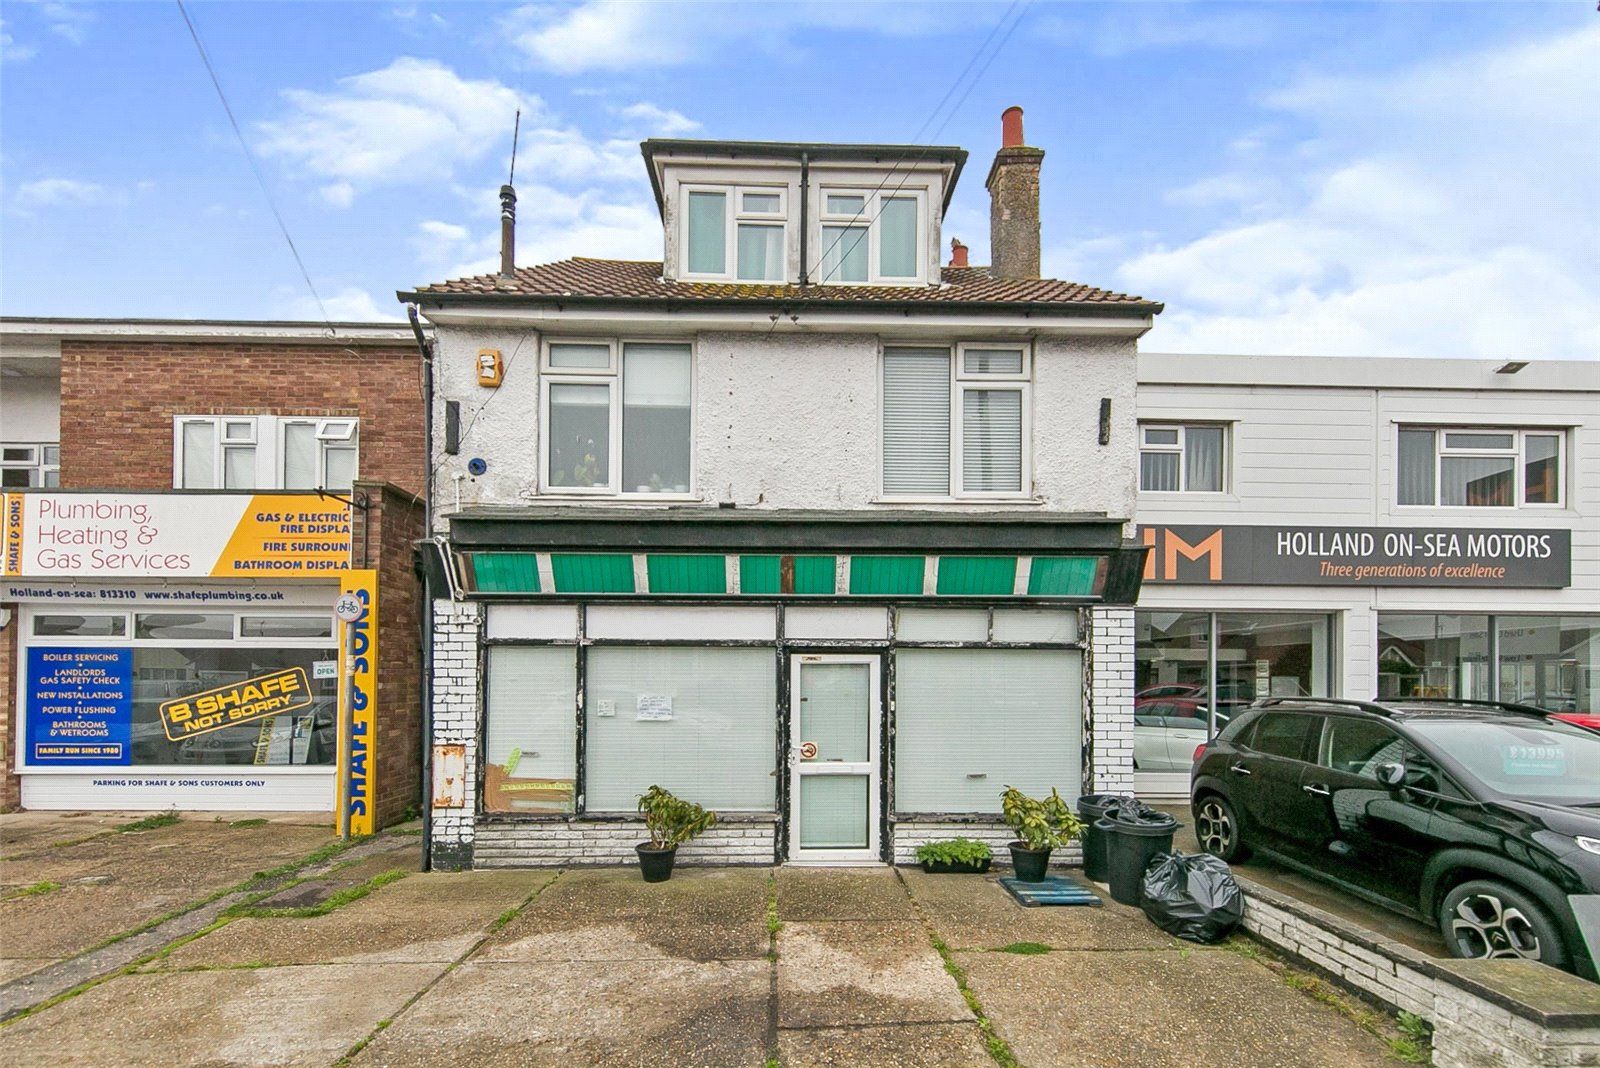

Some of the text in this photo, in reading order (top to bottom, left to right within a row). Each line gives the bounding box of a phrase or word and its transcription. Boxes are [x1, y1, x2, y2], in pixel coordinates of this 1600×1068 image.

[10, 500, 21, 528] SONS
[40, 499, 152, 524] Plumbing,
[256, 513, 351, 522] GAS & ELECTRIC
[280, 525, 304, 534] FIRE
[10, 531, 20, 539] &
[38, 525, 158, 549] Heating &
[263, 542, 351, 552] FIRE SURROUN
[1277, 532, 1552, 558] HOLLAND ON-SEA MOTORS
[9, 542, 20, 573] SHAFE
[37, 549, 190, 569] Gas Services
[234, 560, 350, 570] BATHROOM DISPLA
[1320, 561, 1506, 580] Three generations of excellence
[10, 588, 284, 602] Holland-on-sea: 813310 www.shafeplumbing.co.uk
[43, 653, 119, 661] BOILER SERVICING
[54, 668, 106, 677] LANDLORDS
[317, 667, 335, 675] OPEN
[168, 673, 300, 723] B SHAFE
[42, 706, 117, 714] POWER FLUSHING
[184, 694, 292, 733] NOT SORRY
[52, 720, 107, 729] BATHROOMS
[49, 729, 109, 737] & WETROOMS
